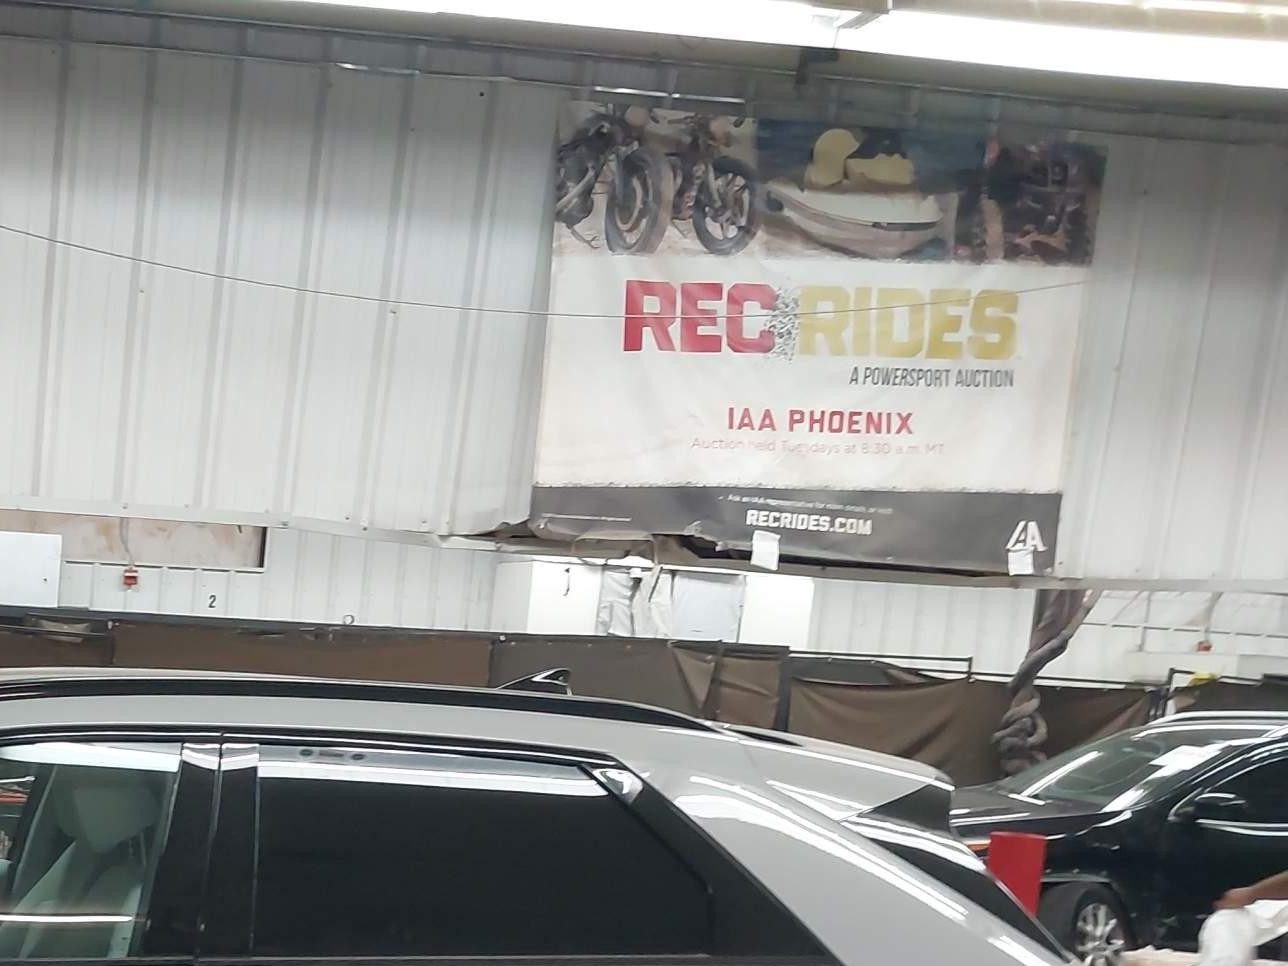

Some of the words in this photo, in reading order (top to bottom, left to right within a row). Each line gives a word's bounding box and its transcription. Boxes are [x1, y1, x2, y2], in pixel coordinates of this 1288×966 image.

[623, 279, 776, 354] REC
[798, 285, 1019, 361] RIDES
[849, 366, 859, 386] A
[862, 367, 951, 388] POWERSPORT
[955, 369, 1014, 388] AUCTION
[728, 407, 775, 432] IAA
[788, 410, 914, 435] PHOENIX
[690, 438, 744, 450] Auction
[747, 438, 776, 451] held
[781, 440, 840, 457] Tuesdays
[844, 442, 857, 454] at
[745, 509, 873, 536] RECRIDES.COM
[208, 594, 216, 609] 2
